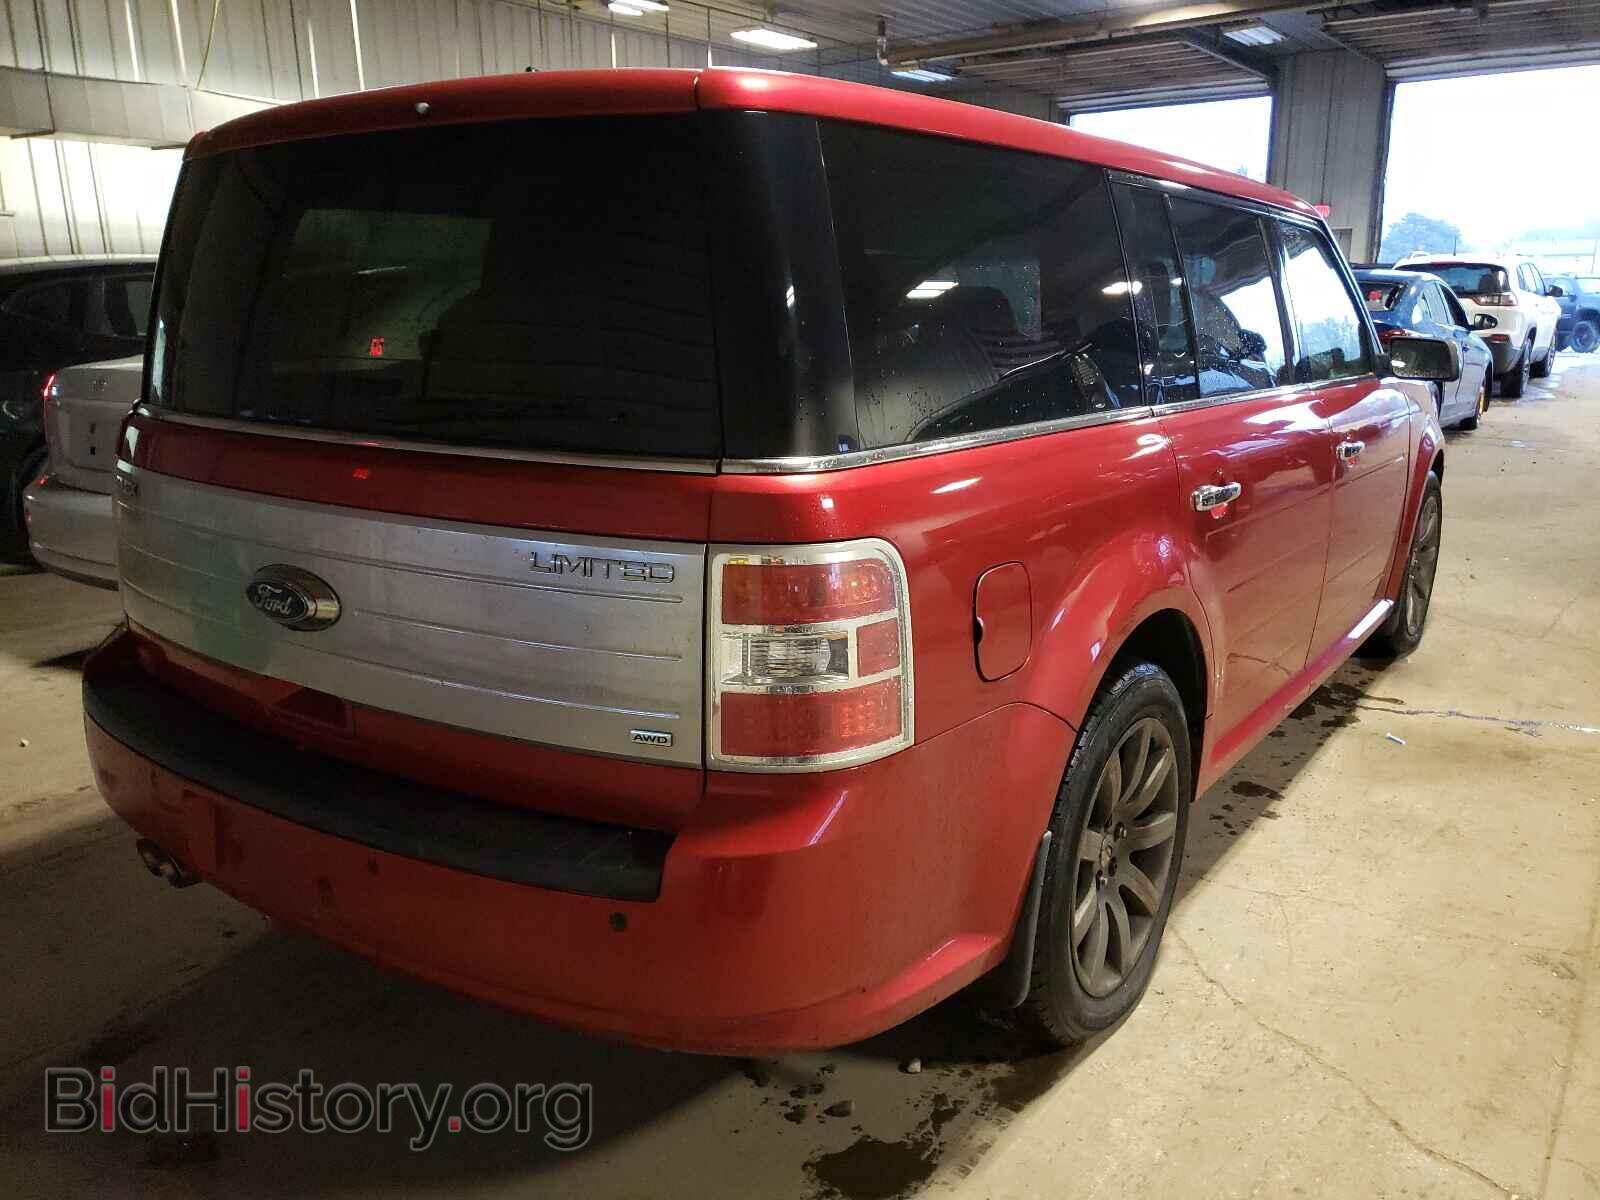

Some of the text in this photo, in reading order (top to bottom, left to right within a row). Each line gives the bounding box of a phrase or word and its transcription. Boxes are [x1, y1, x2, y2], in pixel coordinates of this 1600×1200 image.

[530, 552, 676, 583] LIMITED
[251, 583, 294, 615] Ford
[632, 733, 668, 745] AWD
